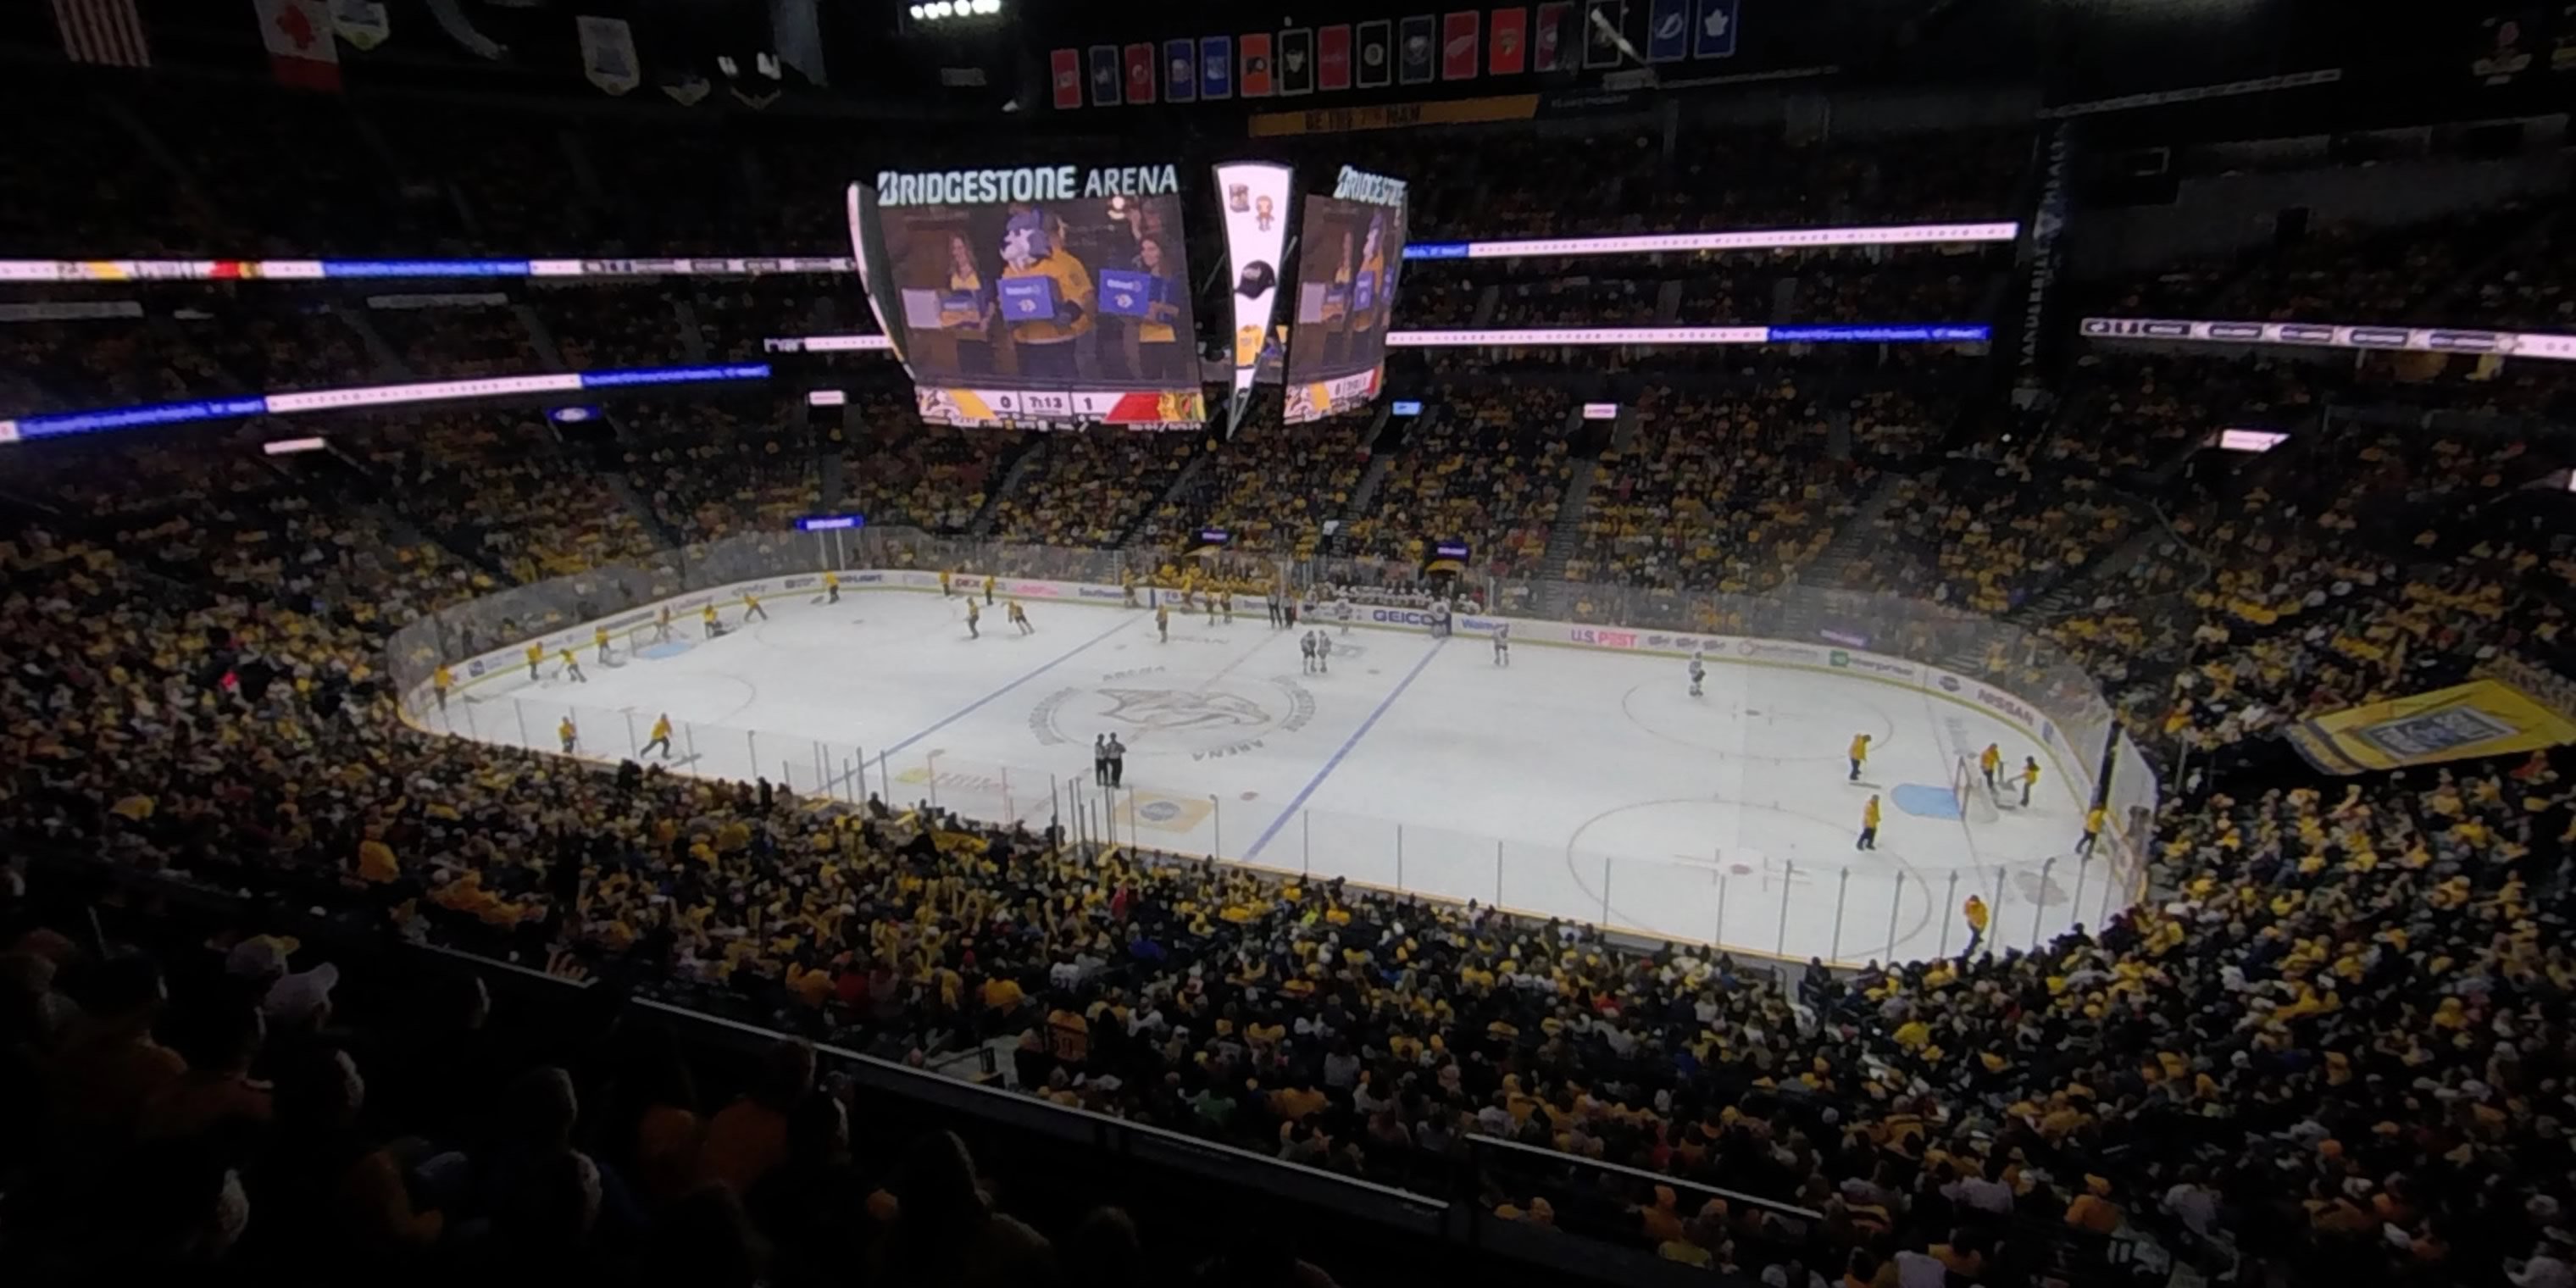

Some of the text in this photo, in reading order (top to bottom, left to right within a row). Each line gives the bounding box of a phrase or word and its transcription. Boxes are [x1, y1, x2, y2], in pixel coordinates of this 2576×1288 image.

[877, 164, 1179, 207] BRIDGESTONE ARENA
[1000, 396, 1092, 409] 0 7:13 1
[1373, 609, 1437, 625] GEICO
[1977, 688, 2034, 727] NISSAN
